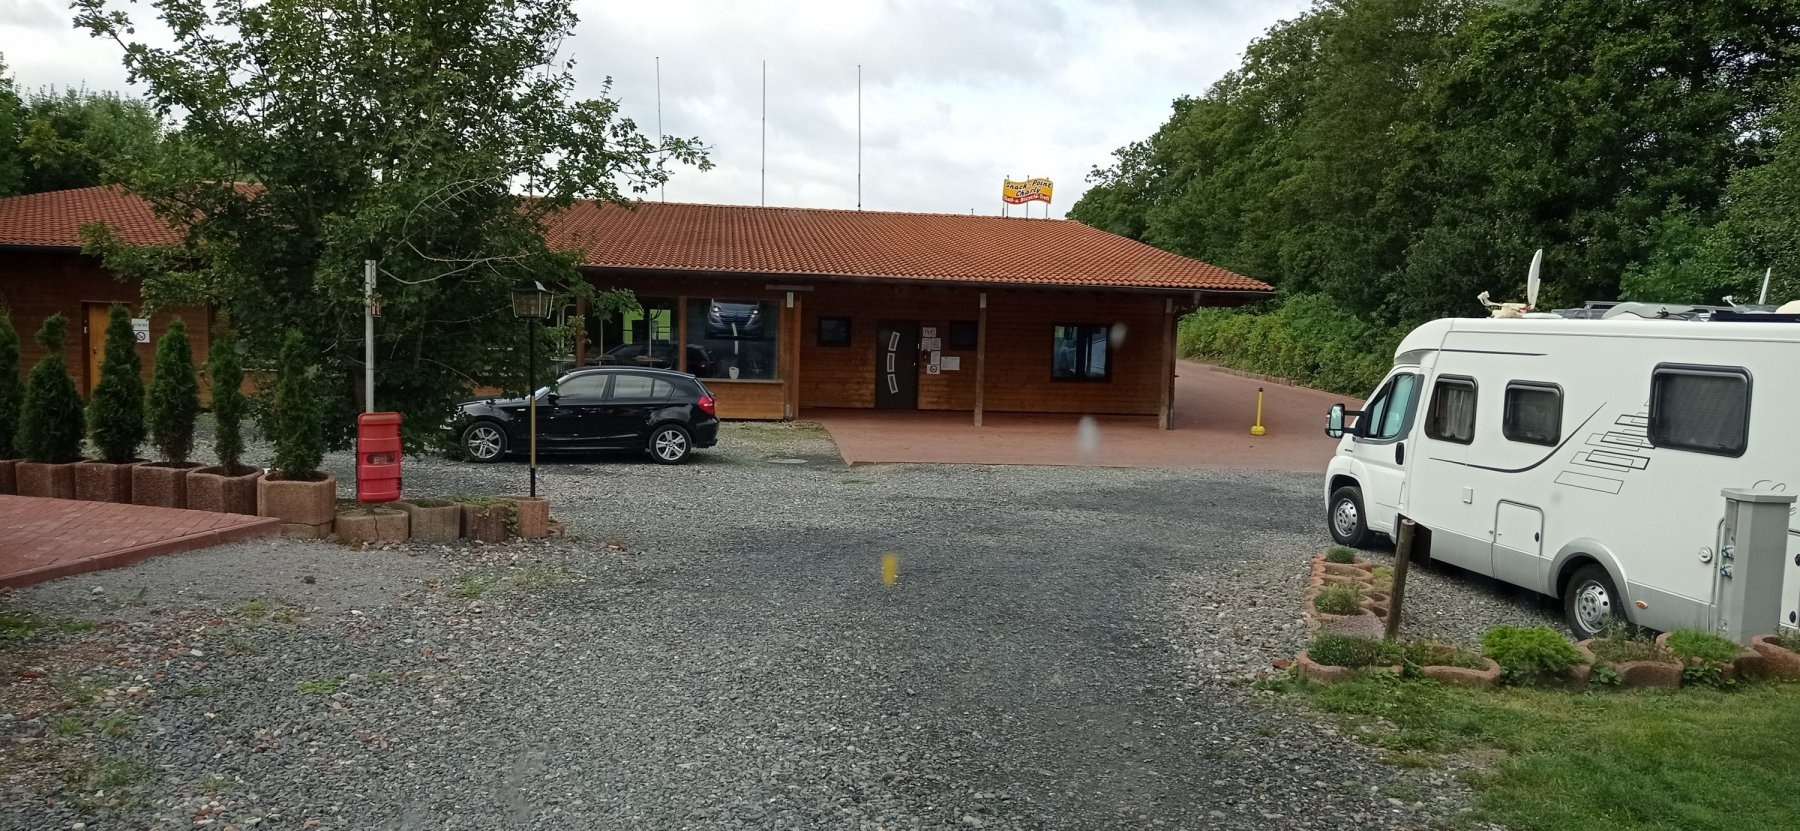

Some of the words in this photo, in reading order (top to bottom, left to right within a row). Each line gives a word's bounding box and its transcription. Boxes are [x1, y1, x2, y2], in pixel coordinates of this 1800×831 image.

[1006, 182, 1027, 190] Snack
[1032, 180, 1051, 188] Point
[1016, 187, 1041, 197] Charly
[924, 329, 936, 337] WC
